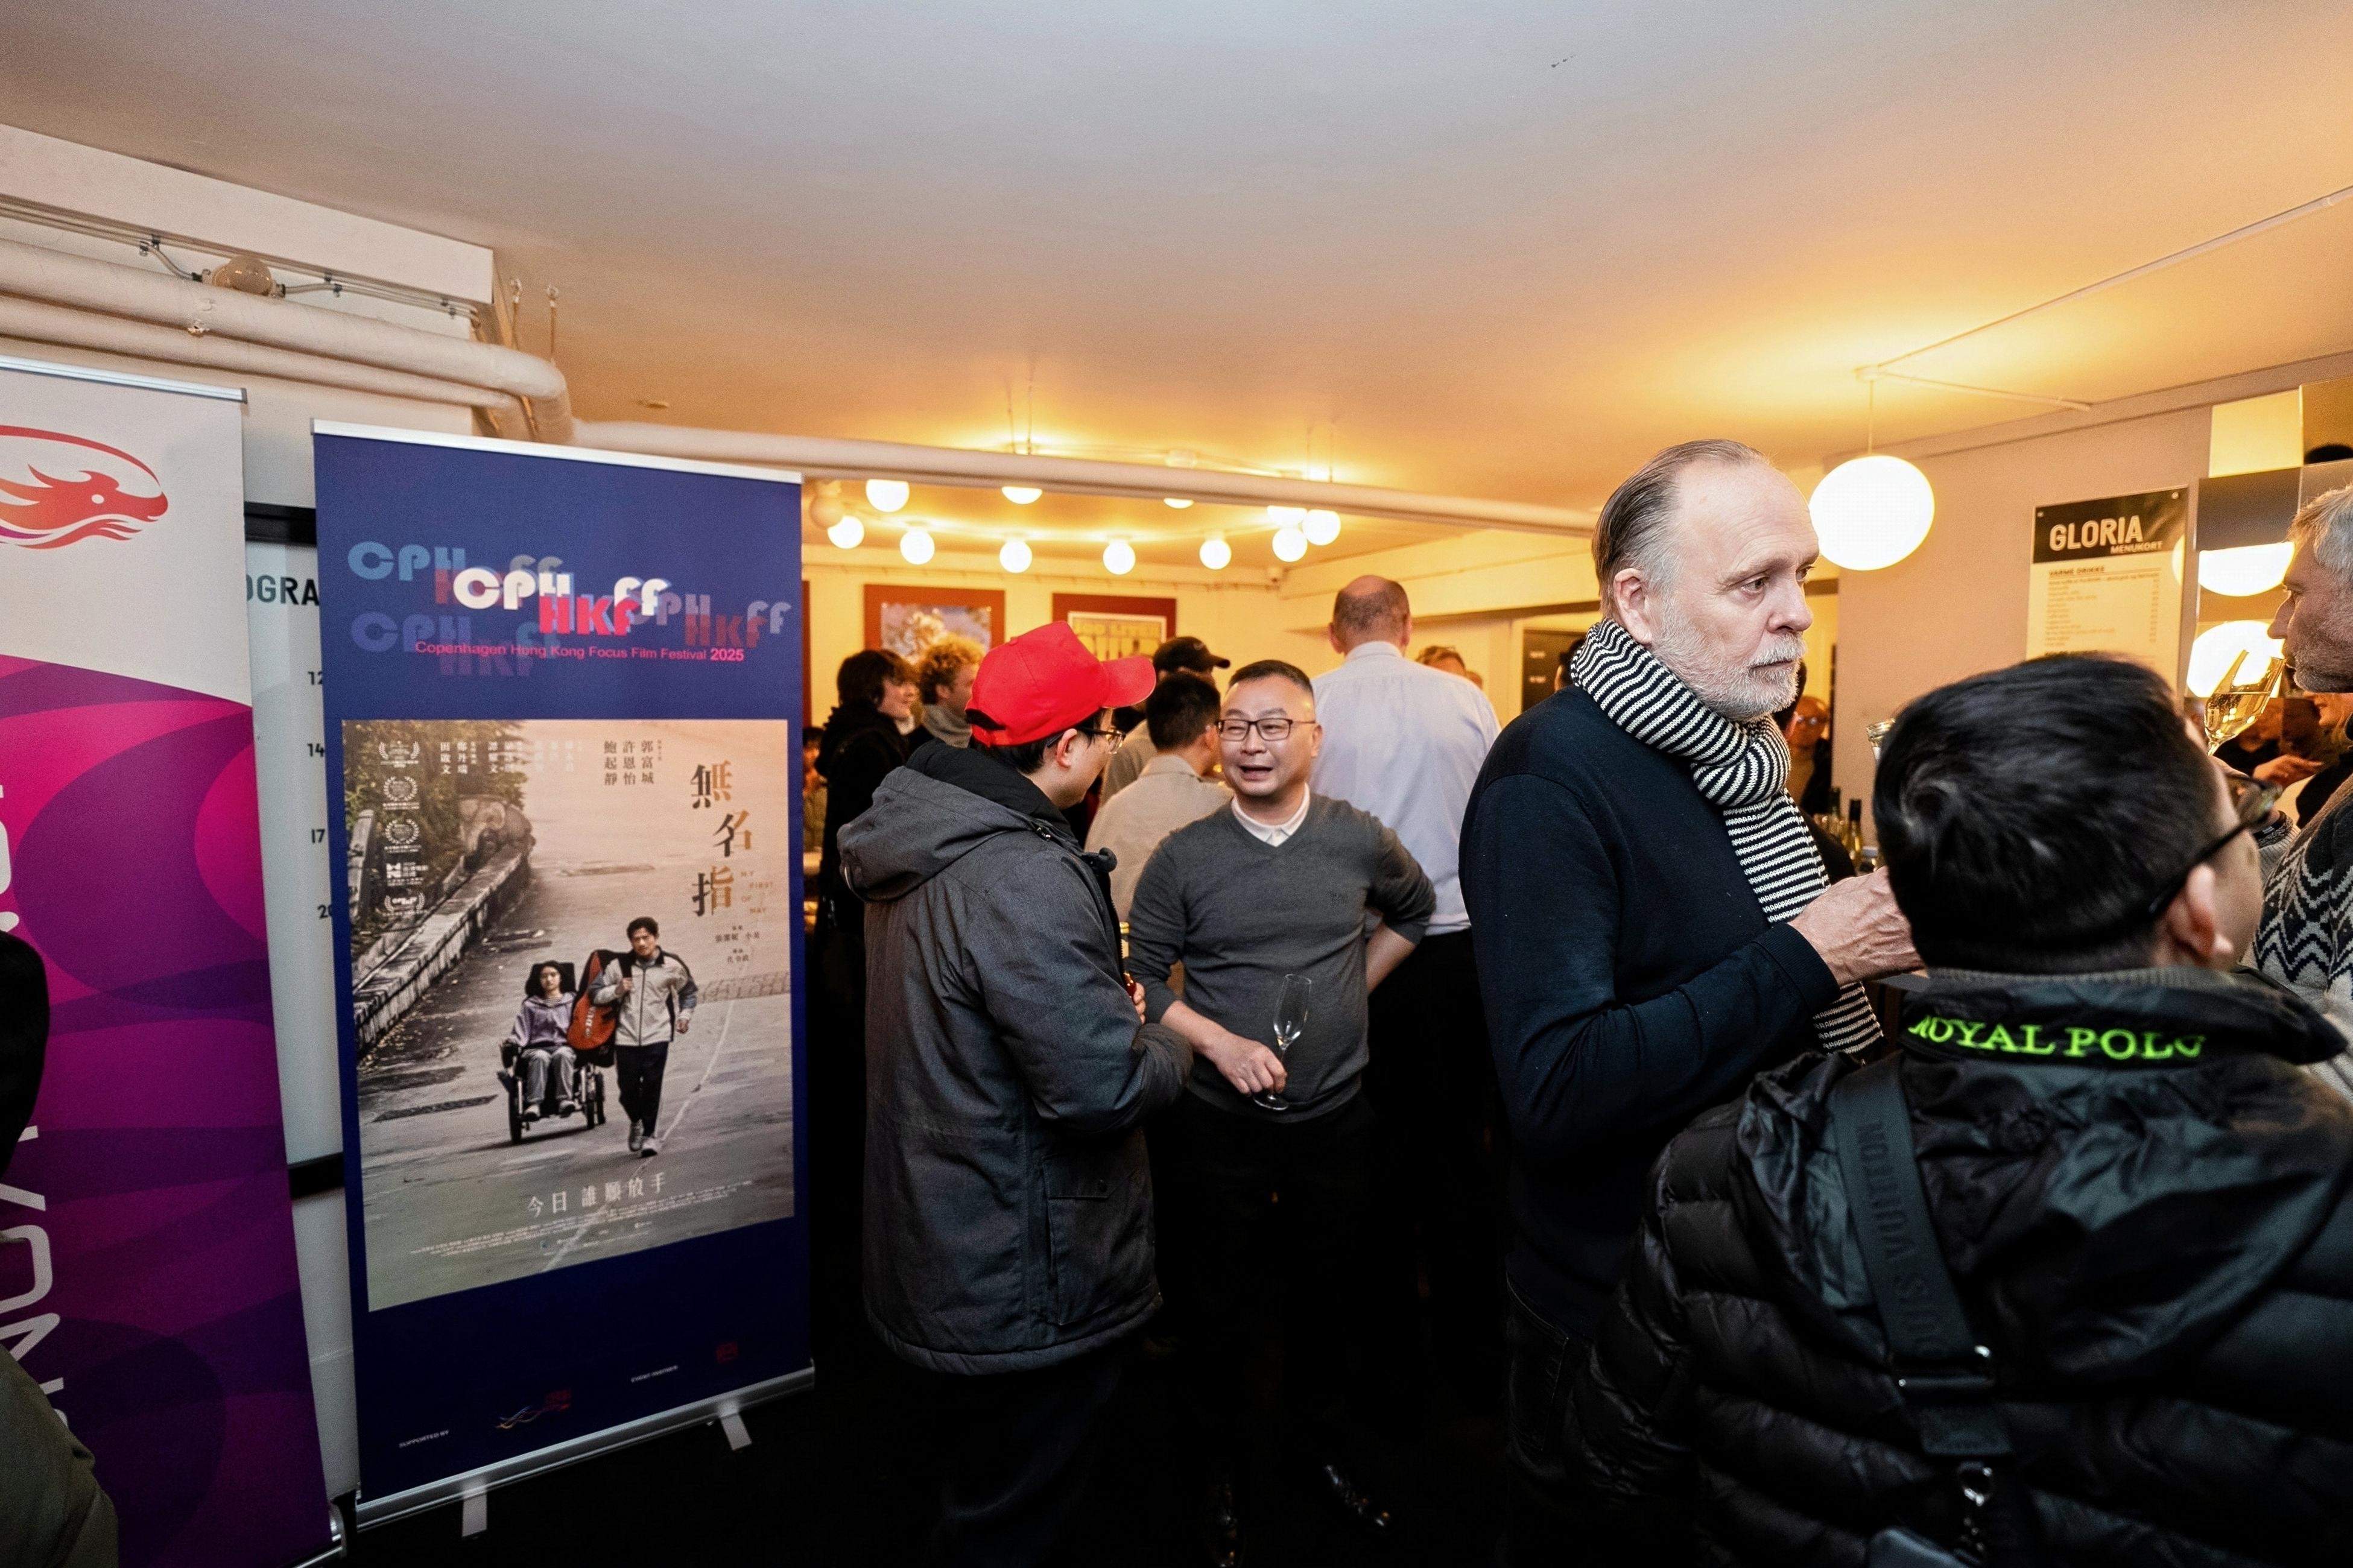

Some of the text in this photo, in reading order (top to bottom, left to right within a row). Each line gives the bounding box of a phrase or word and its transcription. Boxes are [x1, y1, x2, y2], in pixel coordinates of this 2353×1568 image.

[2050, 515, 2144, 551] GLORIA
[2111, 540, 2164, 554] MENUKORT
[453, 567, 571, 610] CPH
[539, 594, 640, 636] HKF
[415, 640, 744, 662] Copenhagen Hong Kong Focus Film Festival 2025
[308, 743, 325, 757] 14
[604, 741, 617, 786] 鮑起靜
[622, 740, 635, 785] 許恩怡
[641, 740, 654, 785] 郭富城
[311, 829, 326, 844] 17
[690, 759, 752, 917] 無名指
